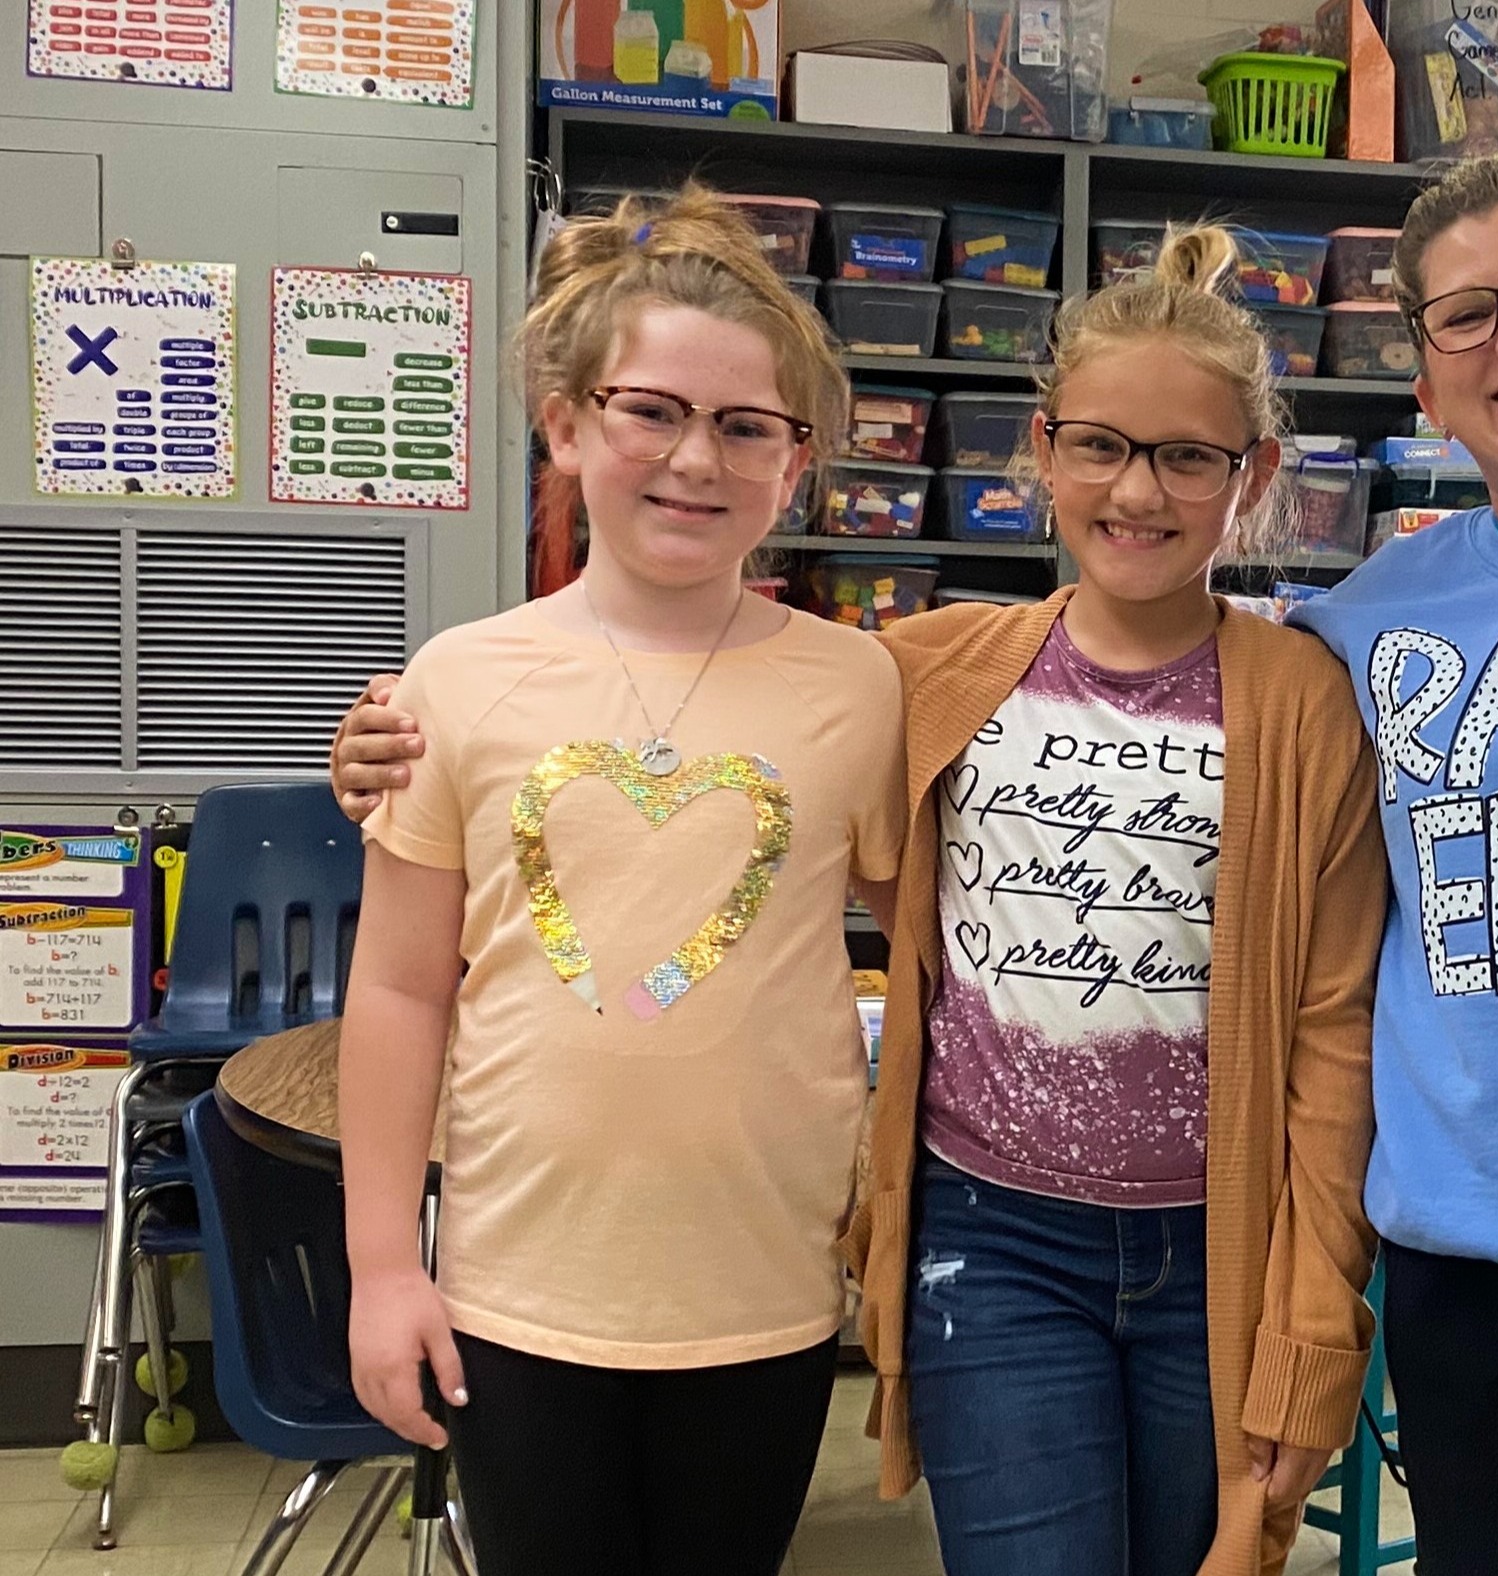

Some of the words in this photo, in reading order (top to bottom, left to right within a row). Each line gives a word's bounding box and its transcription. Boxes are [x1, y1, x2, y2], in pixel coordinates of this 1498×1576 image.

[551, 87, 599, 102] Gallon
[601, 90, 697, 109] Measurement
[700, 98, 722, 111] Set
[854, 251, 918, 266] Brainometry
[54, 286, 212, 309] MULTIPLICATION
[292, 298, 450, 326] SUBTRACTION
[400, 401, 446, 412] difference
[343, 420, 373, 430] deduct
[400, 424, 424, 433] fewer
[298, 440, 316, 450] left
[410, 445, 436, 454] fewer
[1404, 448, 1441, 459] CONNECT
[1033, 732, 1225, 781] prett
[979, 783, 1117, 854] pretty
[1123, 792, 1222, 867] stron
[67, 842, 121, 859] THINKING
[52, 872, 89, 883] number
[988, 856, 1111, 924] pretty
[0, 906, 86, 928] Subtraction
[51, 949, 78, 962] b=?
[8, 966, 20, 975] To
[23, 965, 43, 975] find
[46, 965, 61, 975] the
[64, 965, 91, 976] value
[94, 966, 105, 976] of
[994, 932, 1123, 1008] pretty
[23, 977, 43, 987] add
[48, 978, 66, 987] 117
[69, 978, 79, 987] to
[42, 1008, 85, 1021] b=831
[8, 1049, 75, 1069] Division
[50, 1091, 77, 1104] d=?
[8, 1107, 20, 1116] To
[23, 1106, 42, 1116] find
[45, 1106, 61, 1116] the
[63, 1106, 90, 1116] value
[92, 1107, 103, 1116] of
[17, 1119, 55, 1130] multiply
[60, 1119, 66, 1128] 2
[69, 1120, 93, 1128] times
[45, 1150, 81, 1162] d=24
[18, 1185, 67, 1194] (opposite)
